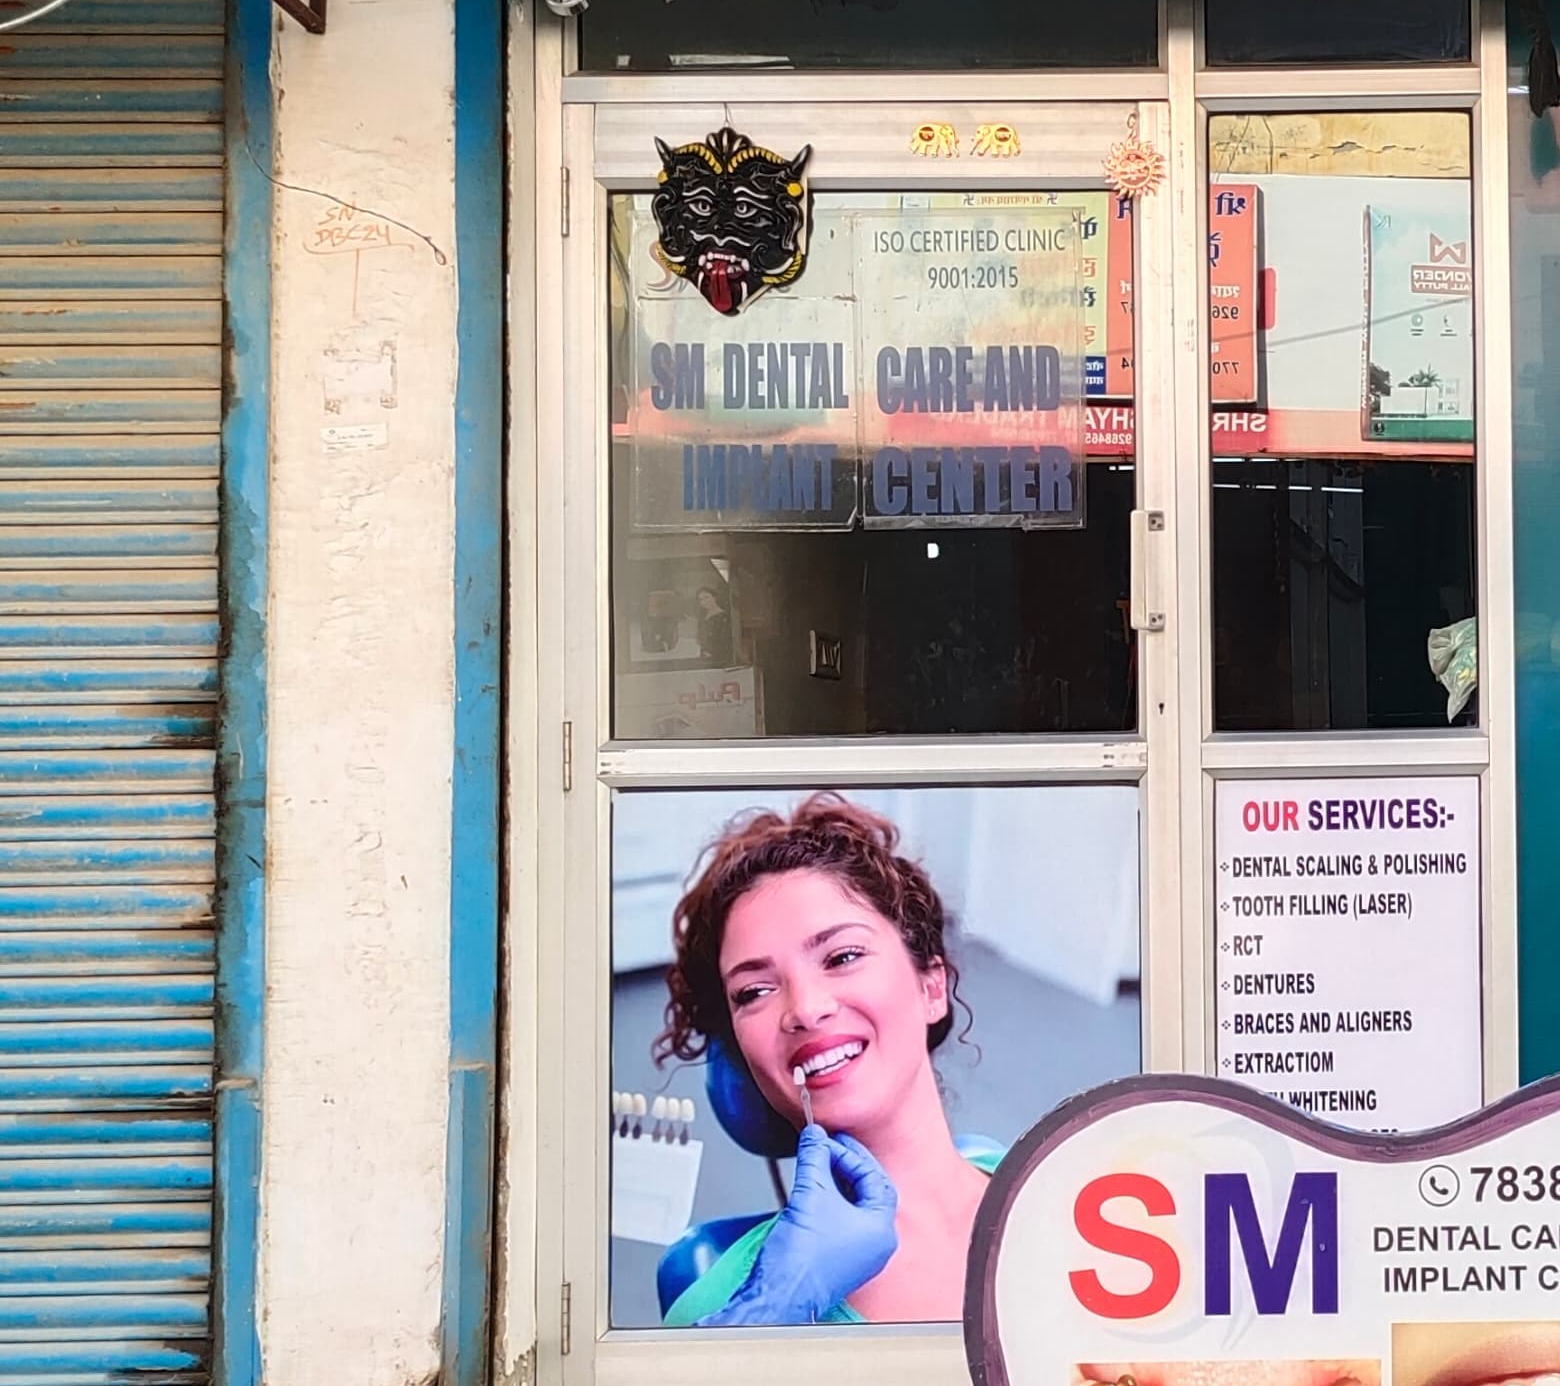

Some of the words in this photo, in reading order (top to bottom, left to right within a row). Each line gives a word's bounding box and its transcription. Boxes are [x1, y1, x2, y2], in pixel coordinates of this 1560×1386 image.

[873, 229, 905, 253] ISO
[910, 229, 1000, 253] CERTIFIED
[1004, 228, 1066, 252] CLINIC
[928, 266, 1019, 289] 9001:2015
[650, 341, 705, 411] SM
[723, 341, 849, 409] DENTAL
[876, 345, 977, 416] CARE
[983, 344, 1061, 412] AND
[682, 443, 838, 511] IMPLANT
[872, 445, 1075, 514] CENTER
[1242, 800, 1300, 832] OUR
[1307, 797, 1455, 831] SERVICES:-
[1232, 856, 1292, 878] DENTAL
[1296, 854, 1363, 877] SCALING
[1367, 854, 1379, 876] &
[1383, 852, 1467, 876] POLISHING
[1232, 894, 1285, 917] TOOTH
[1289, 893, 1349, 916] FILLING
[1353, 892, 1413, 921] (LASER)
[1233, 935, 1264, 957] RCT
[1233, 973, 1316, 996] DENTURES
[1234, 1012, 1295, 1035] BRACES
[1299, 1012, 1332, 1034] AND
[1335, 1010, 1413, 1033] ALIGNERS
[1067, 1171, 1340, 1321] SM
[1372, 1224, 1501, 1254] DENTAL
[1383, 1264, 1529, 1295] IMPLANT
